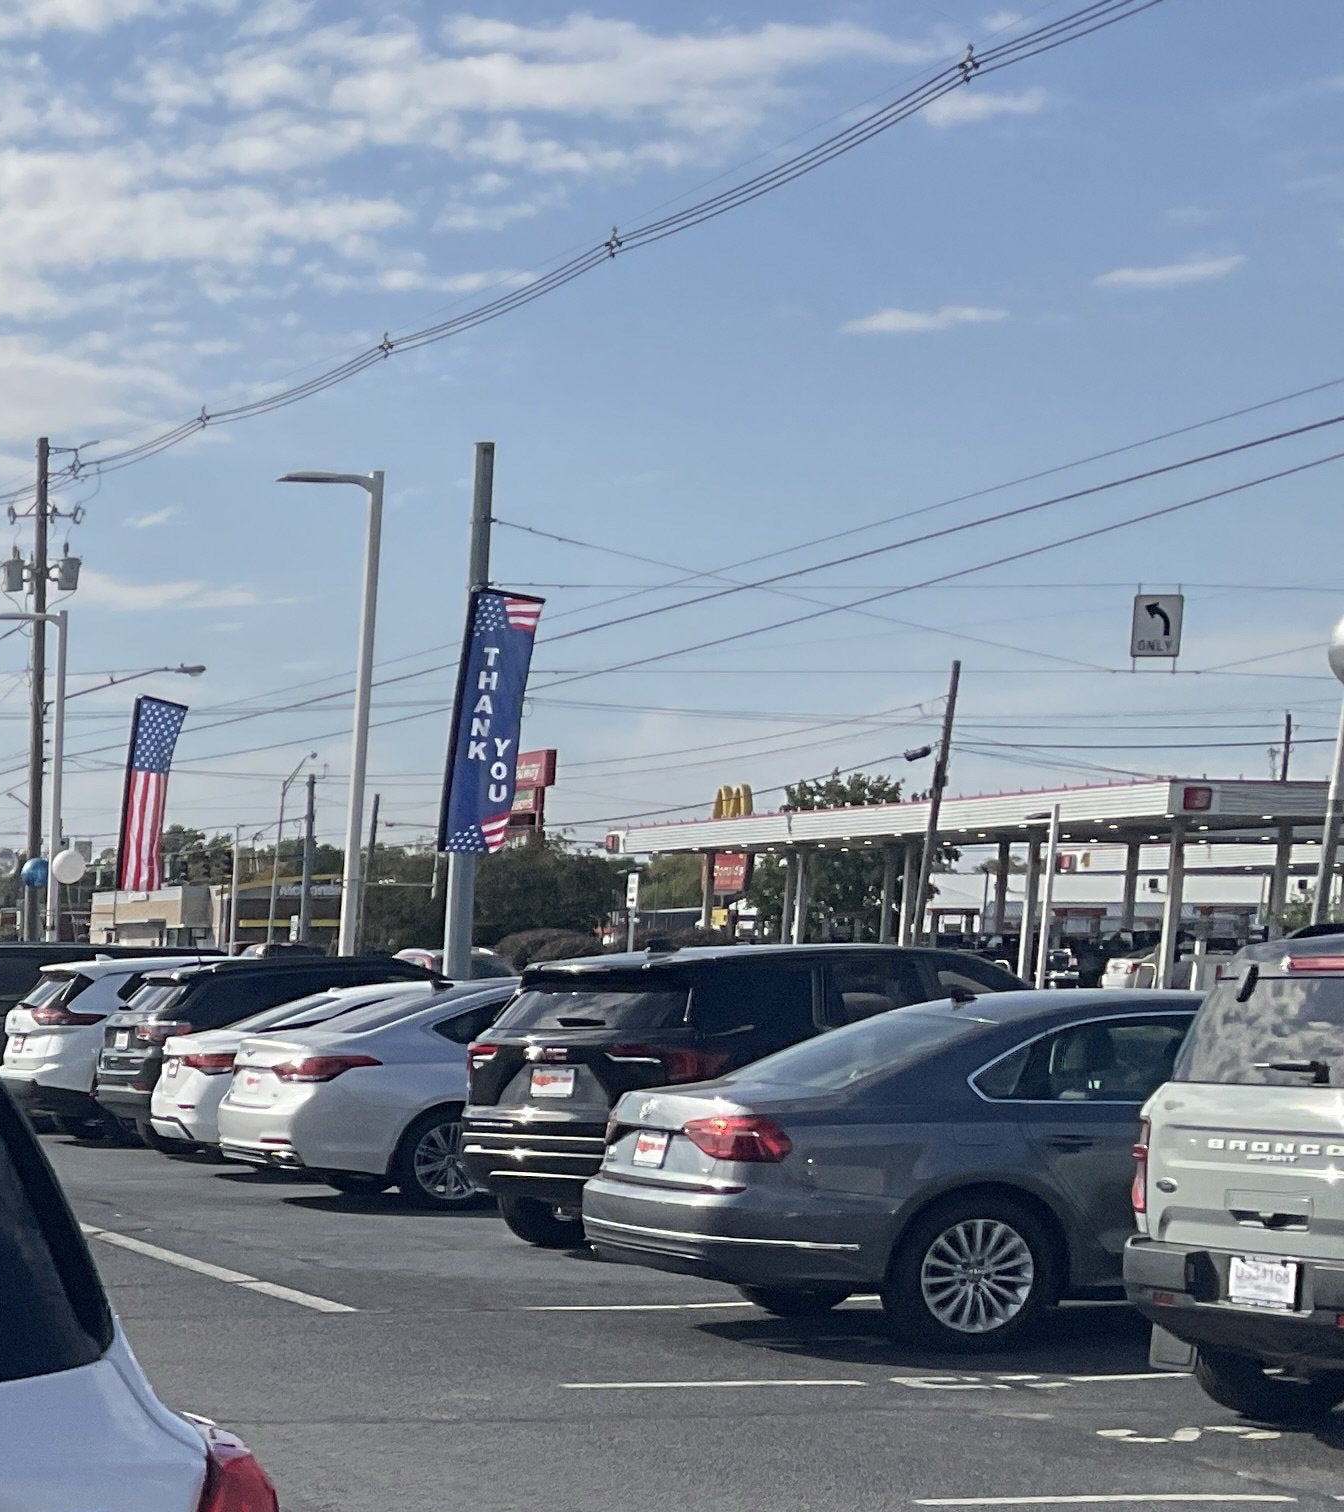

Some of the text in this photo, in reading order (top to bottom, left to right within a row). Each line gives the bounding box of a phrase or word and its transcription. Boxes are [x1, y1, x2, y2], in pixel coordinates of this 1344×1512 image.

[1137, 640, 1172, 652] ONLY
[467, 647, 512, 803] THANK YOU
[1207, 1138, 1344, 1157] BRONCO
